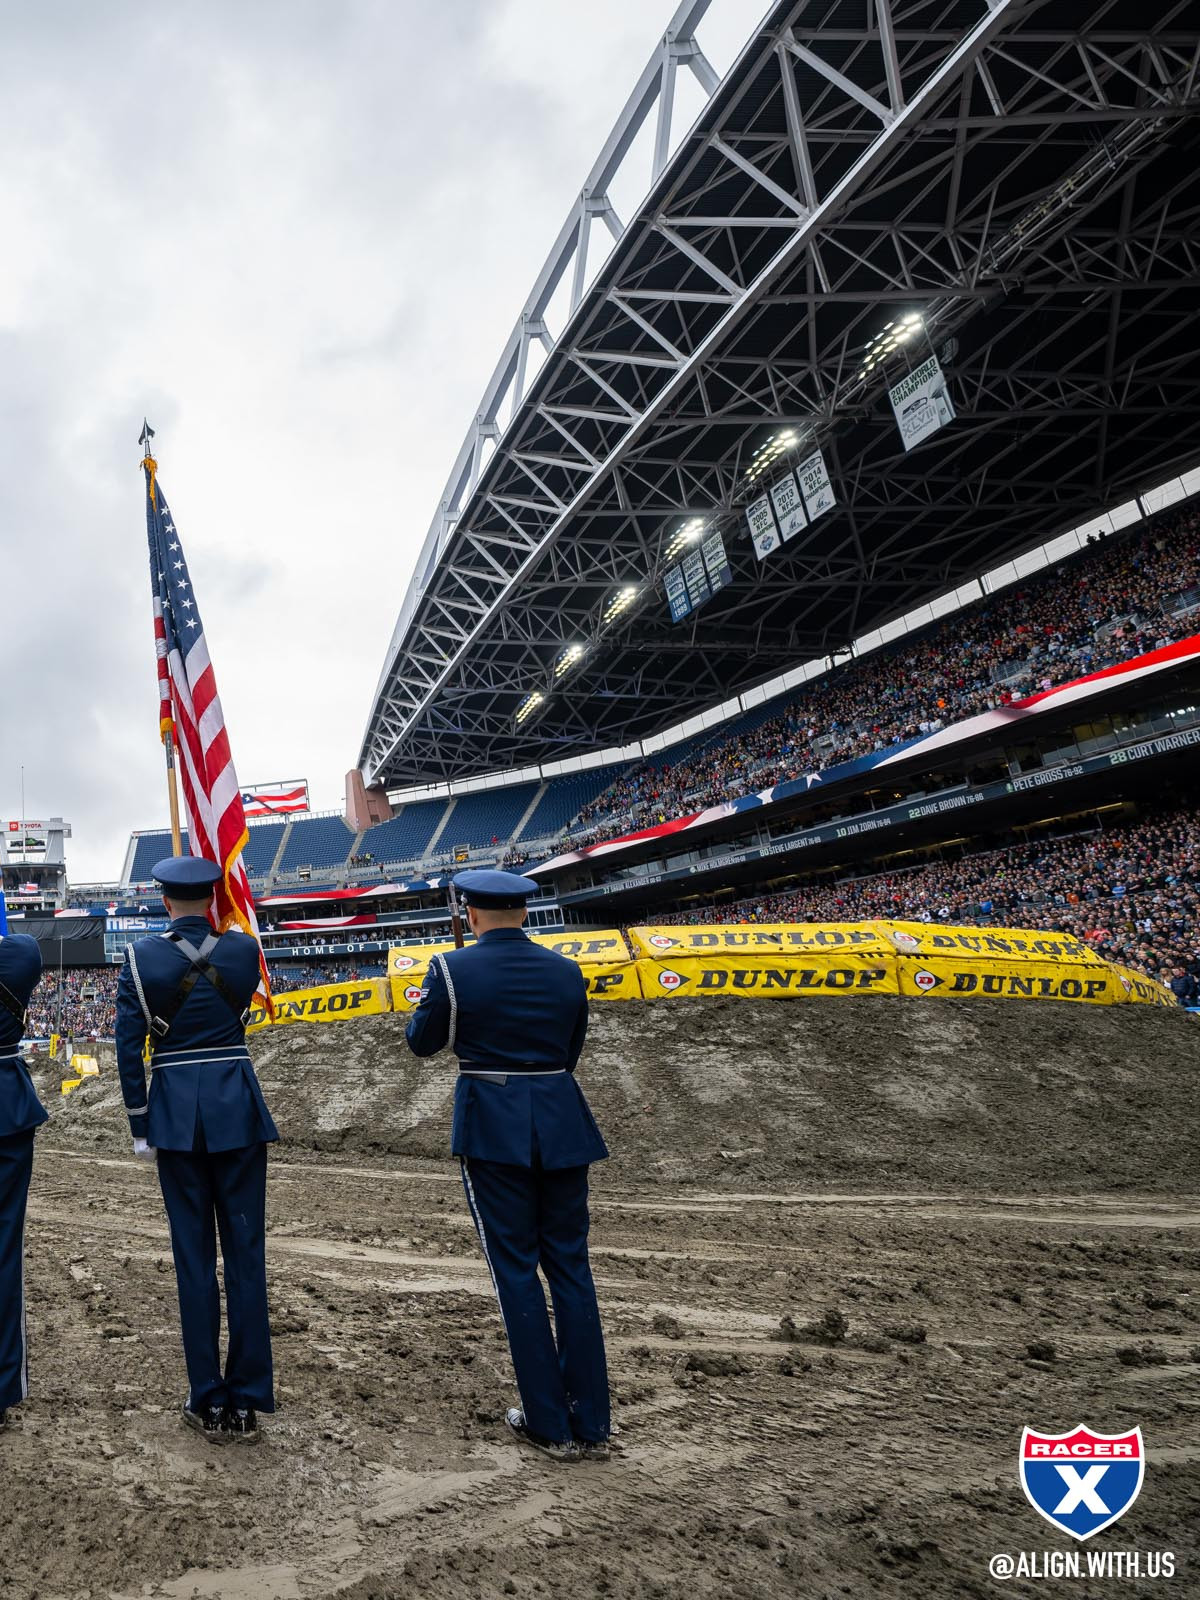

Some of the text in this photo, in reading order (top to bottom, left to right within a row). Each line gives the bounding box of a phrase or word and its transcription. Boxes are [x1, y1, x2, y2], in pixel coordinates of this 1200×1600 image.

[890, 358, 936, 400] 2013 WORLD
[892, 366, 938, 407] CHAMPIONS
[803, 466, 822, 486] 2014
[808, 477, 822, 491] NFC
[777, 488, 794, 506] 2013
[804, 480, 830, 501] CHAMPIONS
[779, 502, 802, 521] CHAMPIONS
[781, 499, 794, 512] NFC
[751, 509, 768, 526] 2005
[756, 518, 768, 531] NFC
[752, 521, 775, 541] CHAMPIONS
[1109, 730, 1200, 765] 28 CURT WARNER
[1013, 765, 1084, 792] PETE GROSS 76-92
[909, 809, 921, 819] 22
[921, 802, 939, 816] DAVE
[939, 796, 966, 811] BROWN
[836, 827, 847, 838] 10
[847, 823, 860, 836] JIM
[860, 820, 877, 832] ZORN
[759, 847, 769, 857] 80
[769, 844, 785, 856] STEVE
[785, 838, 808, 851] LARGENT
[106, 918, 147, 930] MPS
[292, 946, 335, 956] HOME
[347, 944, 365, 953] OF
[377, 940, 406, 950] THE
[688, 931, 876, 947] DUNLOP
[932, 935, 1086, 956] DUNLOP
[696, 969, 886, 989] DUNLOP
[949, 972, 1107, 999] DUNLOP
